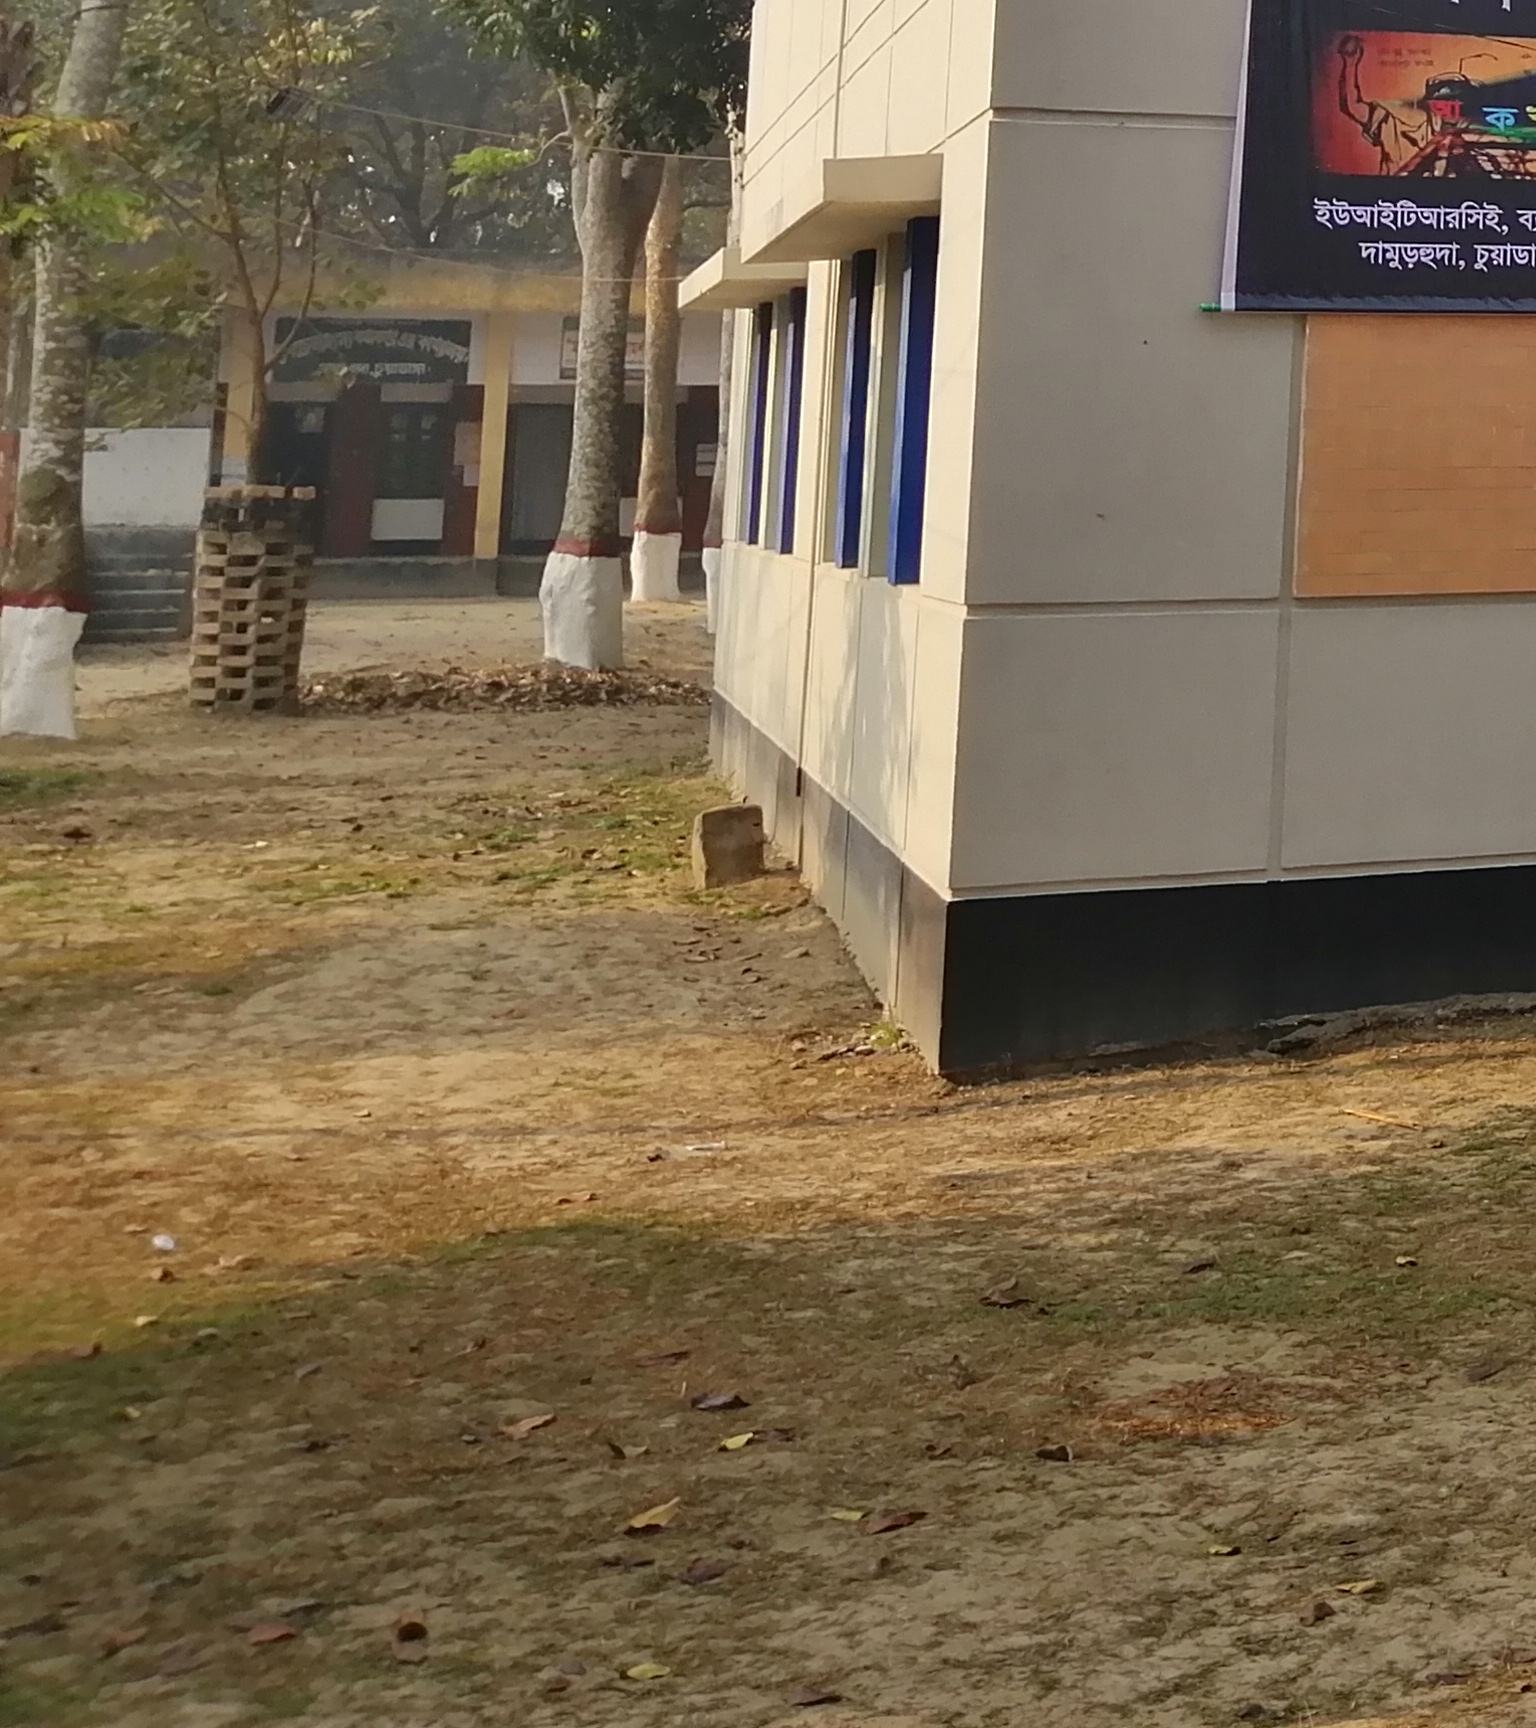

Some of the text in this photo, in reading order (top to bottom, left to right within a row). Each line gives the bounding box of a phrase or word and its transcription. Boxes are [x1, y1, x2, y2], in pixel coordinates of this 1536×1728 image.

[1481, 107, 1519, 131] ক
[1312, 197, 1509, 235] ইউআইটিআরসিই,
[1358, 240, 1466, 270] দামুড়হুদা,
